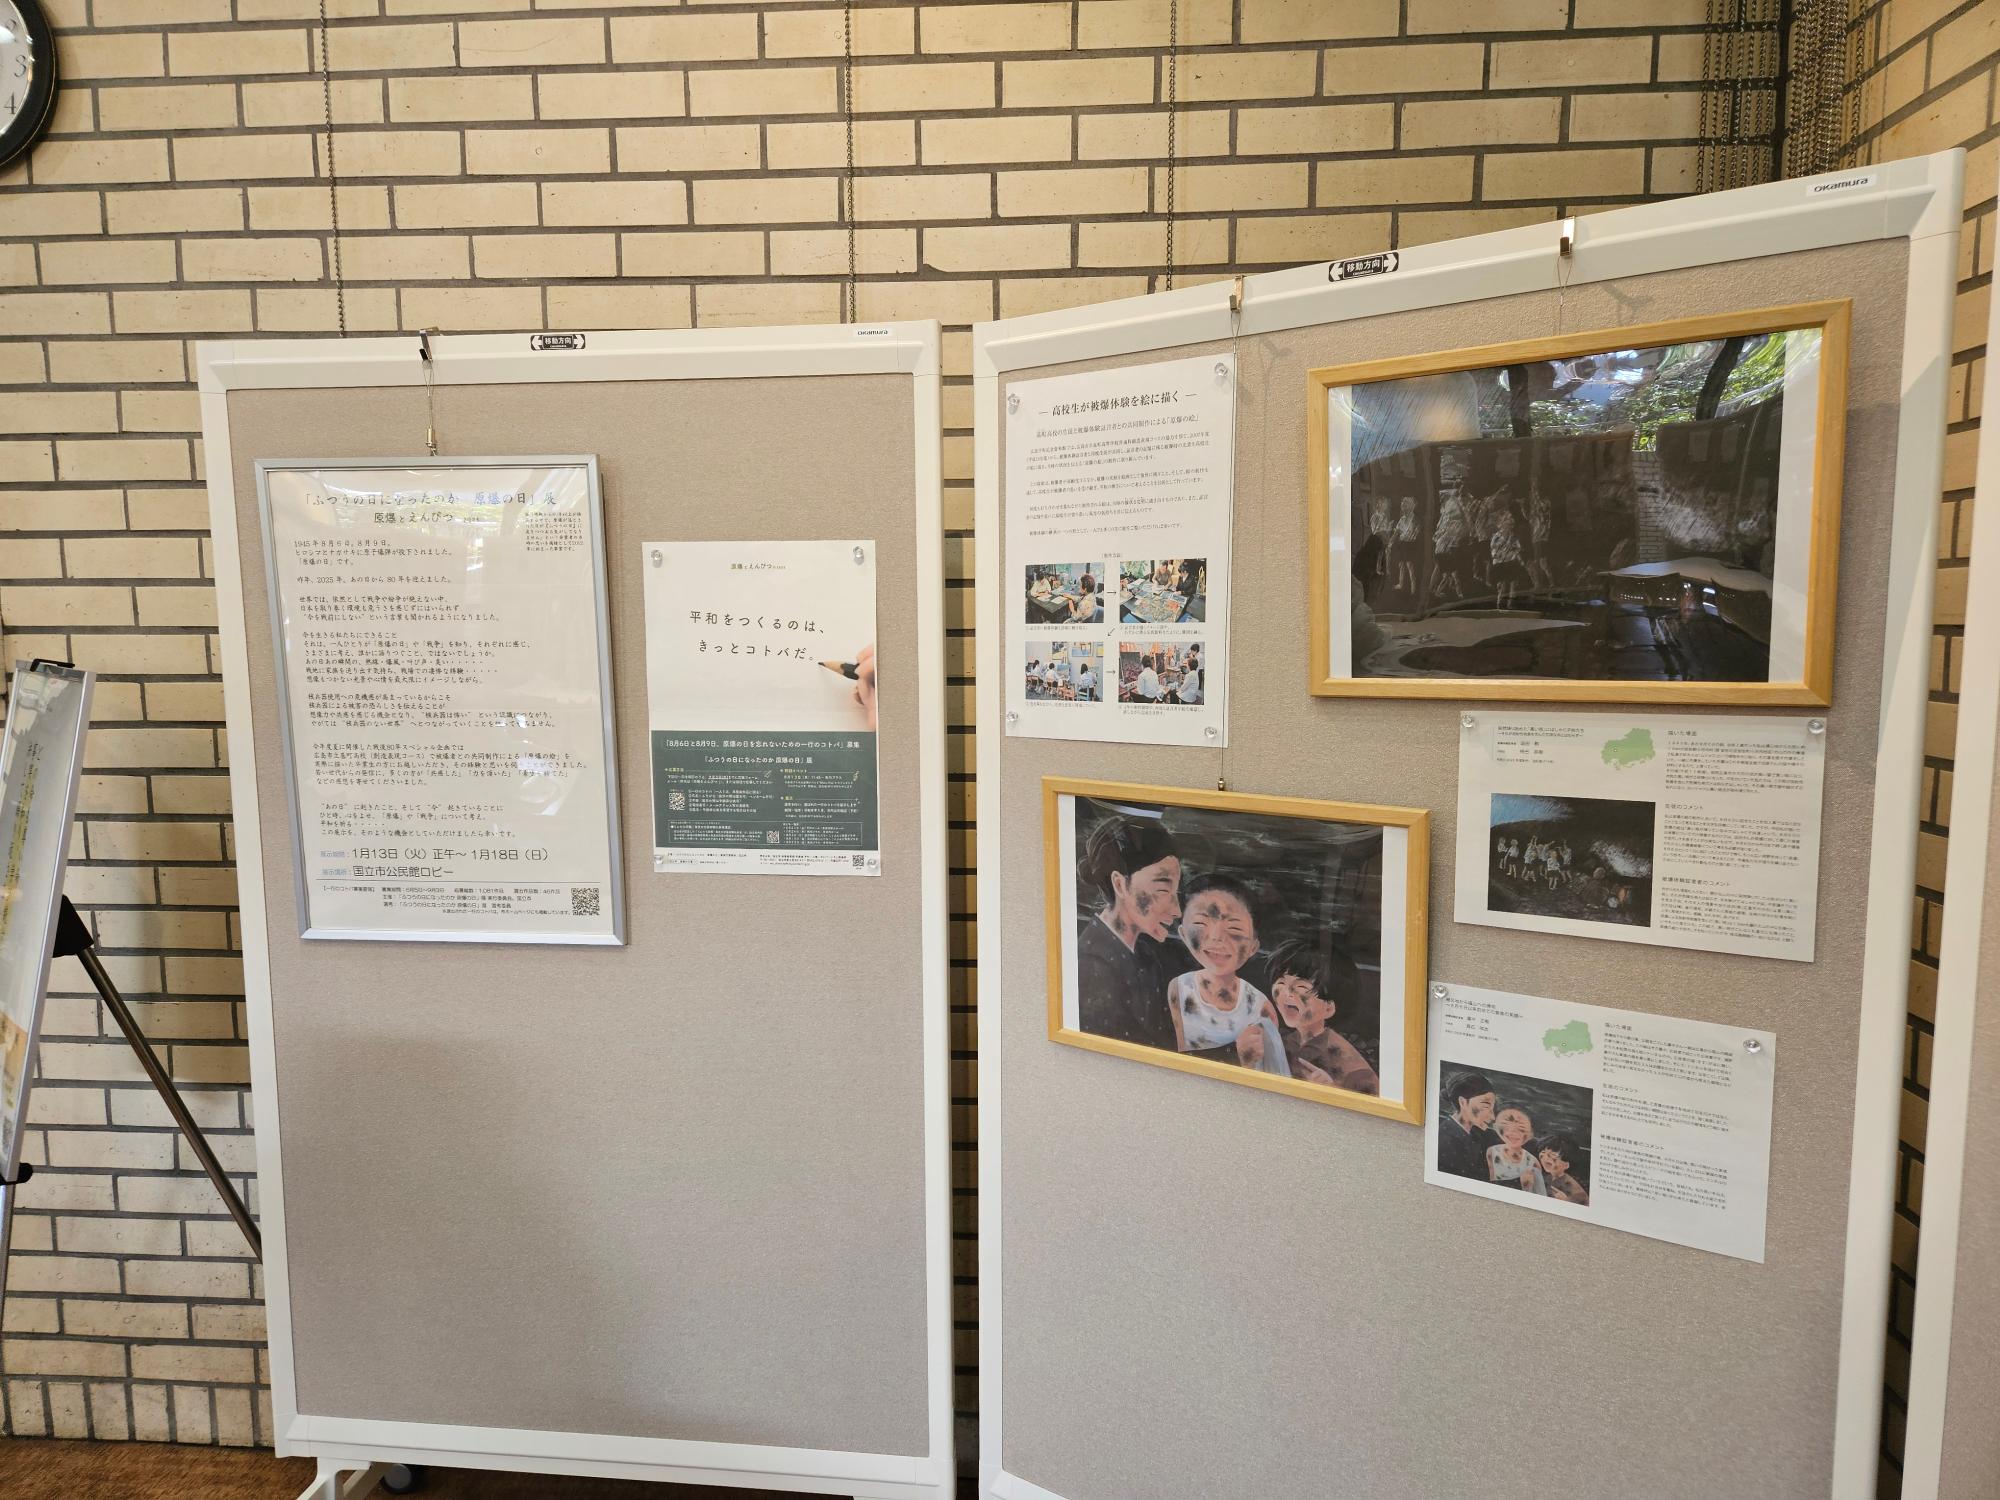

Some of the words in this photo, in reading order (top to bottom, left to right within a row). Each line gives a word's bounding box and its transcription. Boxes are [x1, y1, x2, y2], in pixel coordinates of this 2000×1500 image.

[3, 91, 17, 115] 4
[1346, 259, 1381, 273] 移動方向
[544, 337, 572, 345] 移動方向
[374, 511, 454, 524] 原爆とえんぴつ
[690, 610, 825, 634] 平和をつくるのは、
[699, 639, 814, 661] きっとコトバだ。
[352, 865, 454, 878] 国立市公民館ロビー
